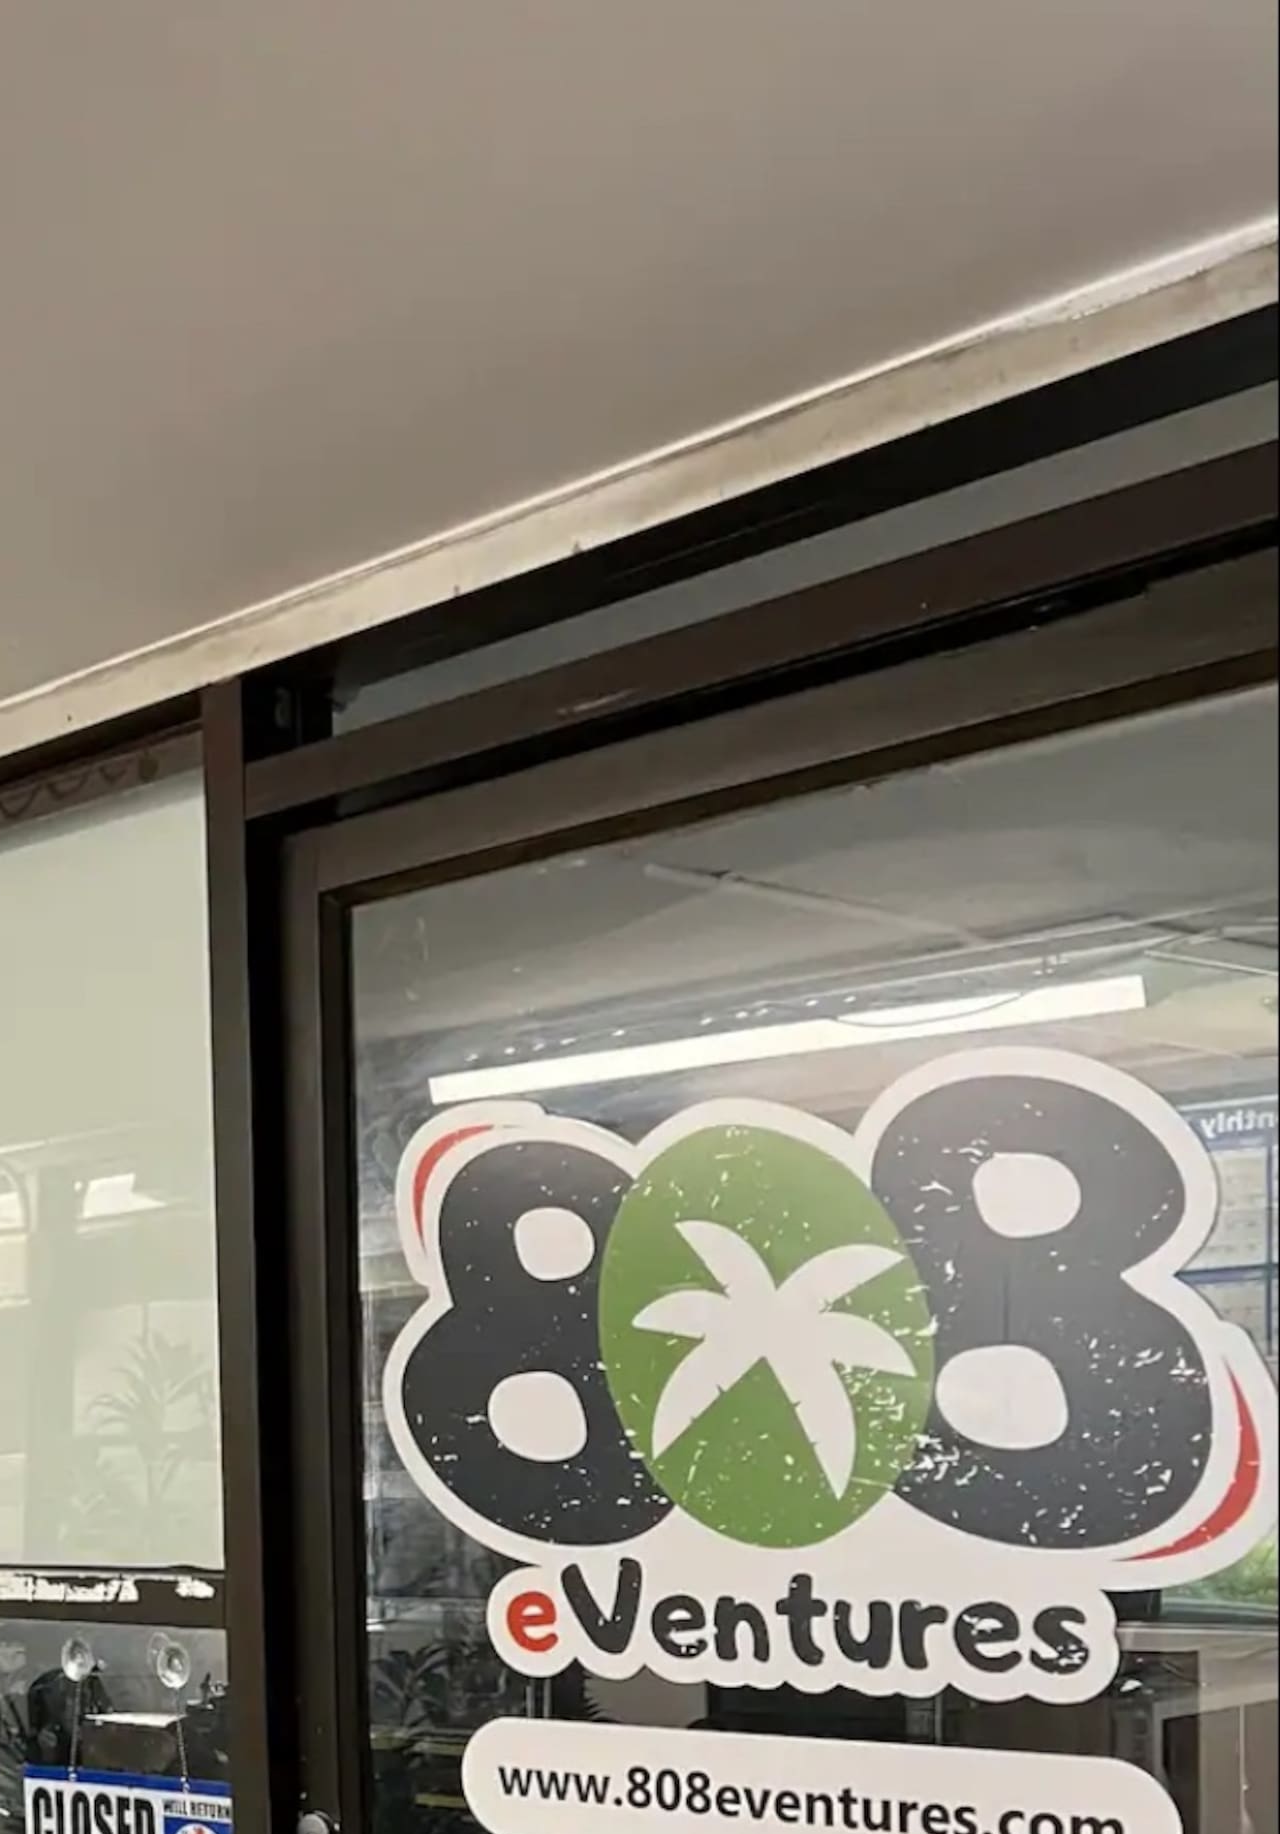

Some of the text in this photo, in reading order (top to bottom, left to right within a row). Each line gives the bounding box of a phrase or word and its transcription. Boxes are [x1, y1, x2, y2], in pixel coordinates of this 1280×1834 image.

[402, 1074, 1214, 1551] 808
[506, 1557, 1092, 1674] eVentures
[190, 1801, 232, 1819] RETURN
